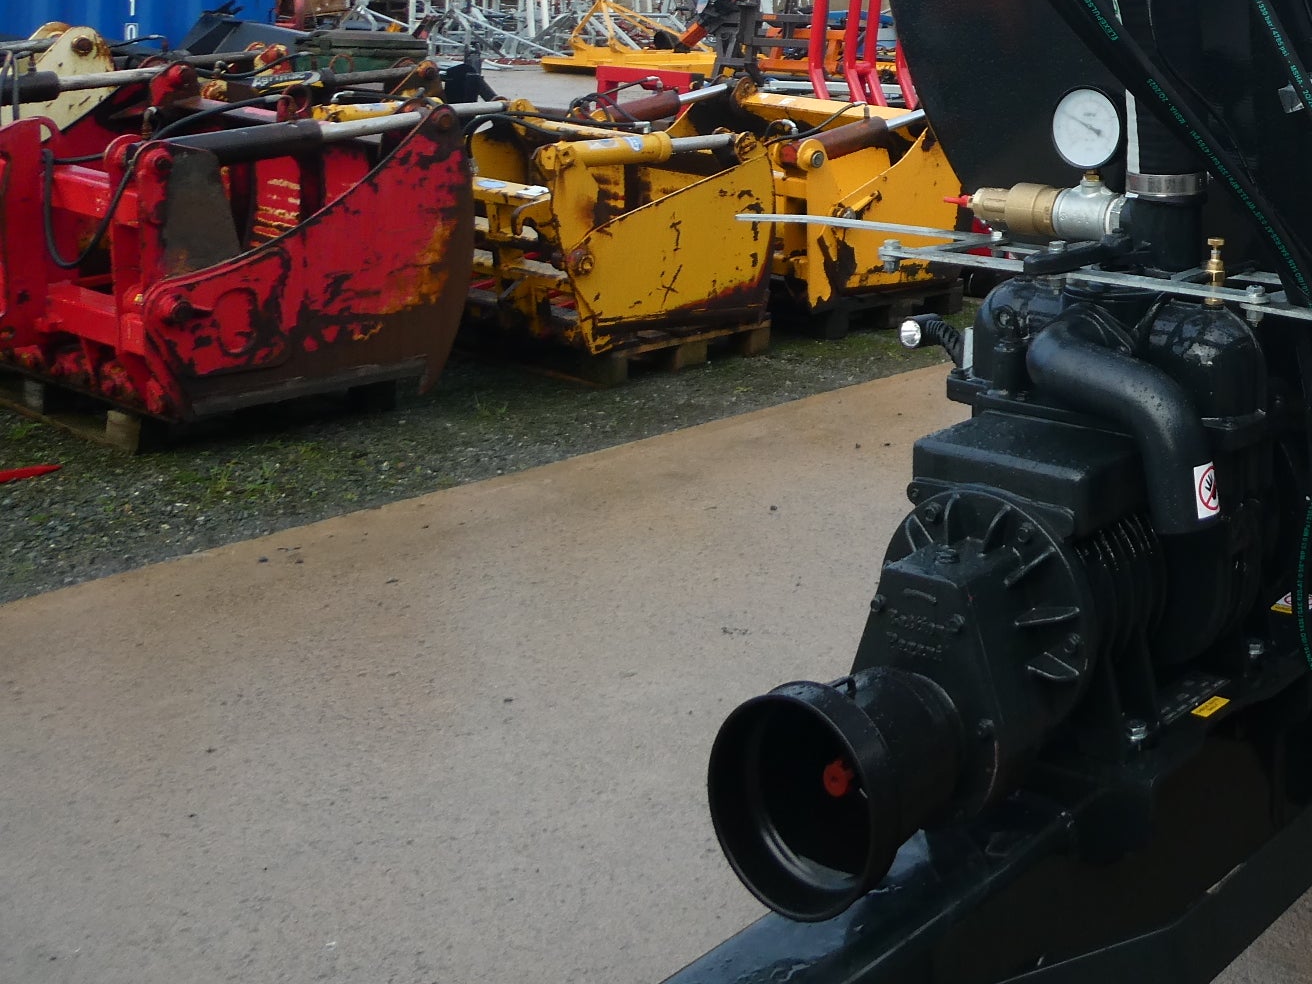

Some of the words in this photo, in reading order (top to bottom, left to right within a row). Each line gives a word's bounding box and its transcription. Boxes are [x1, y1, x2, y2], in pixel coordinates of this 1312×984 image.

[1265, 15, 1273, 27] bar
[1279, 45, 1290, 57] psi
[1290, 65, 1303, 84] MSHA
